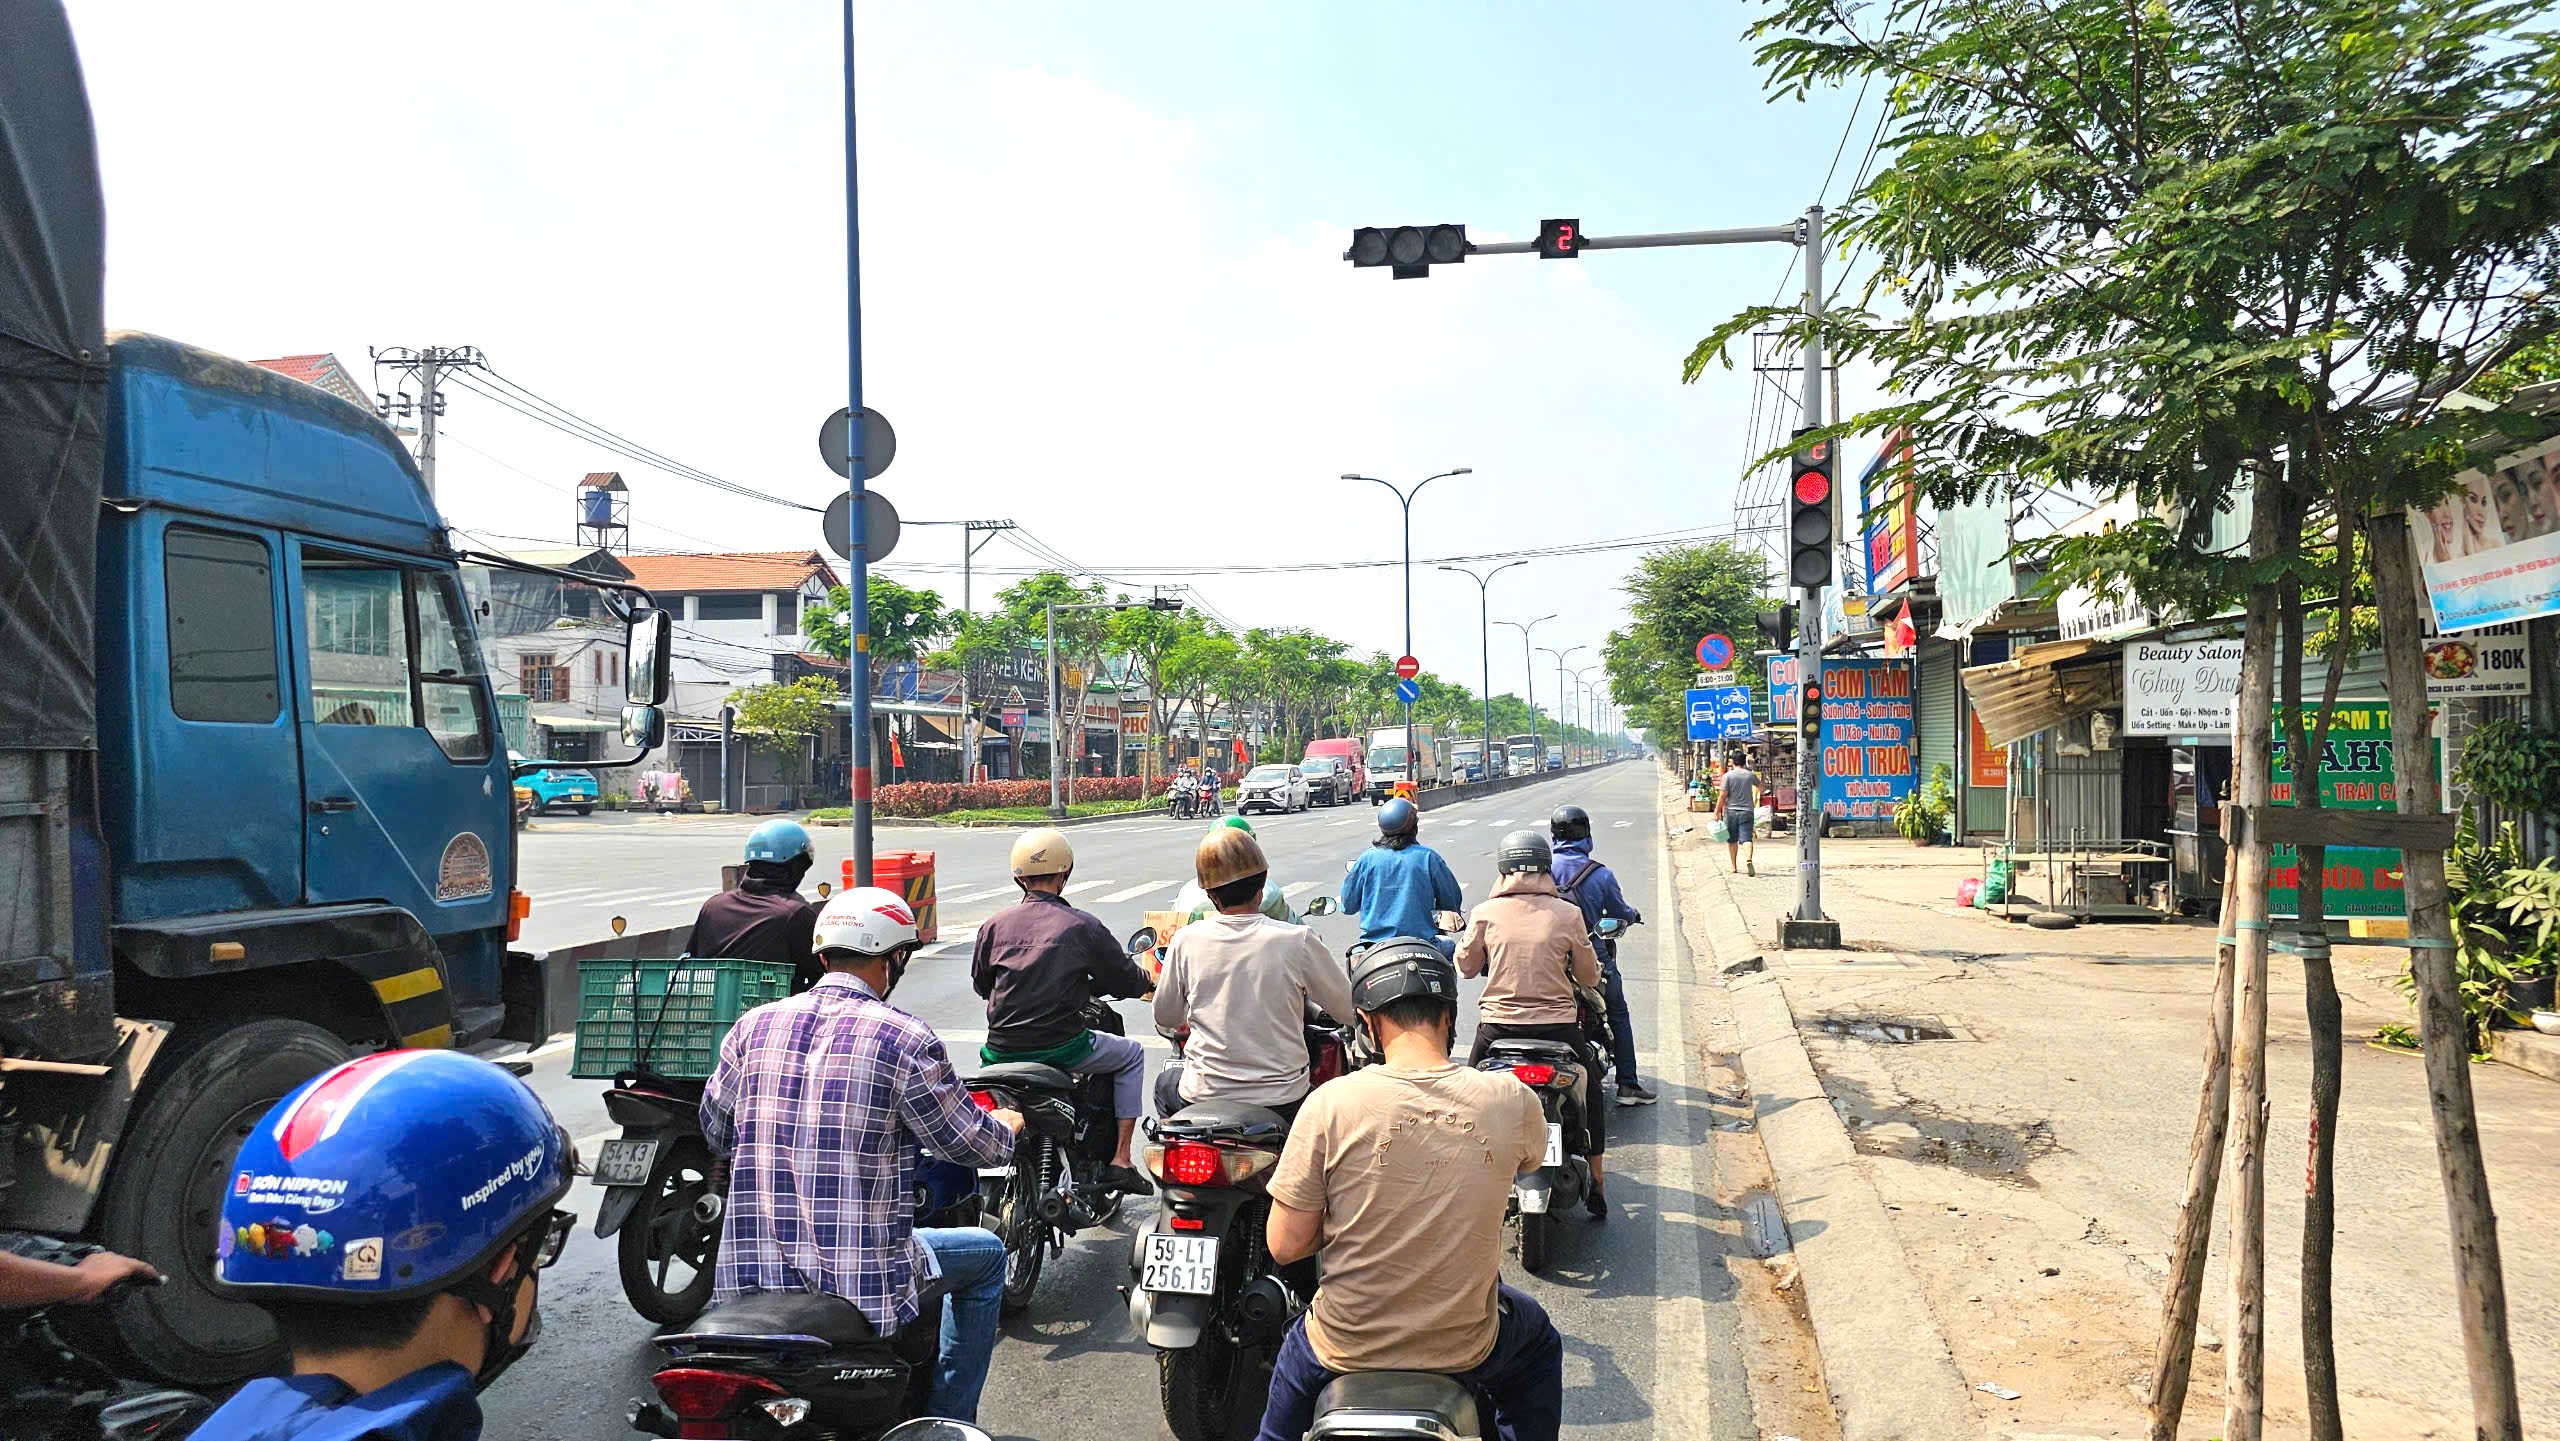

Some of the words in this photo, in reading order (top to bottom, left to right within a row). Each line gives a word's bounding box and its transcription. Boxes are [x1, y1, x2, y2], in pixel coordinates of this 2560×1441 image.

[1558, 225, 1572, 250] 2
[2139, 646, 2193, 663] Beauty
[2197, 645, 2241, 660] Salon
[2480, 648, 2525, 670] 180K
[1771, 657, 1799, 685] CƠ
[1823, 665, 1865, 698] CƠM
[2147, 720, 2171, 731] Setting
[2178, 720, 2196, 729] Make
[2198, 721, 2208, 730] Up
[1823, 745, 1863, 776] CƠM
[1867, 744, 1912, 776] TRƯA
[2334, 780, 2374, 801] TRÁI
[282, 1176, 348, 1194] NIPPON
[461, 1166, 512, 1211] Inspired
[510, 1159, 524, 1176] by
[1155, 1238, 1205, 1263] 59-L1
[1145, 1265, 1212, 1290] 256.15
